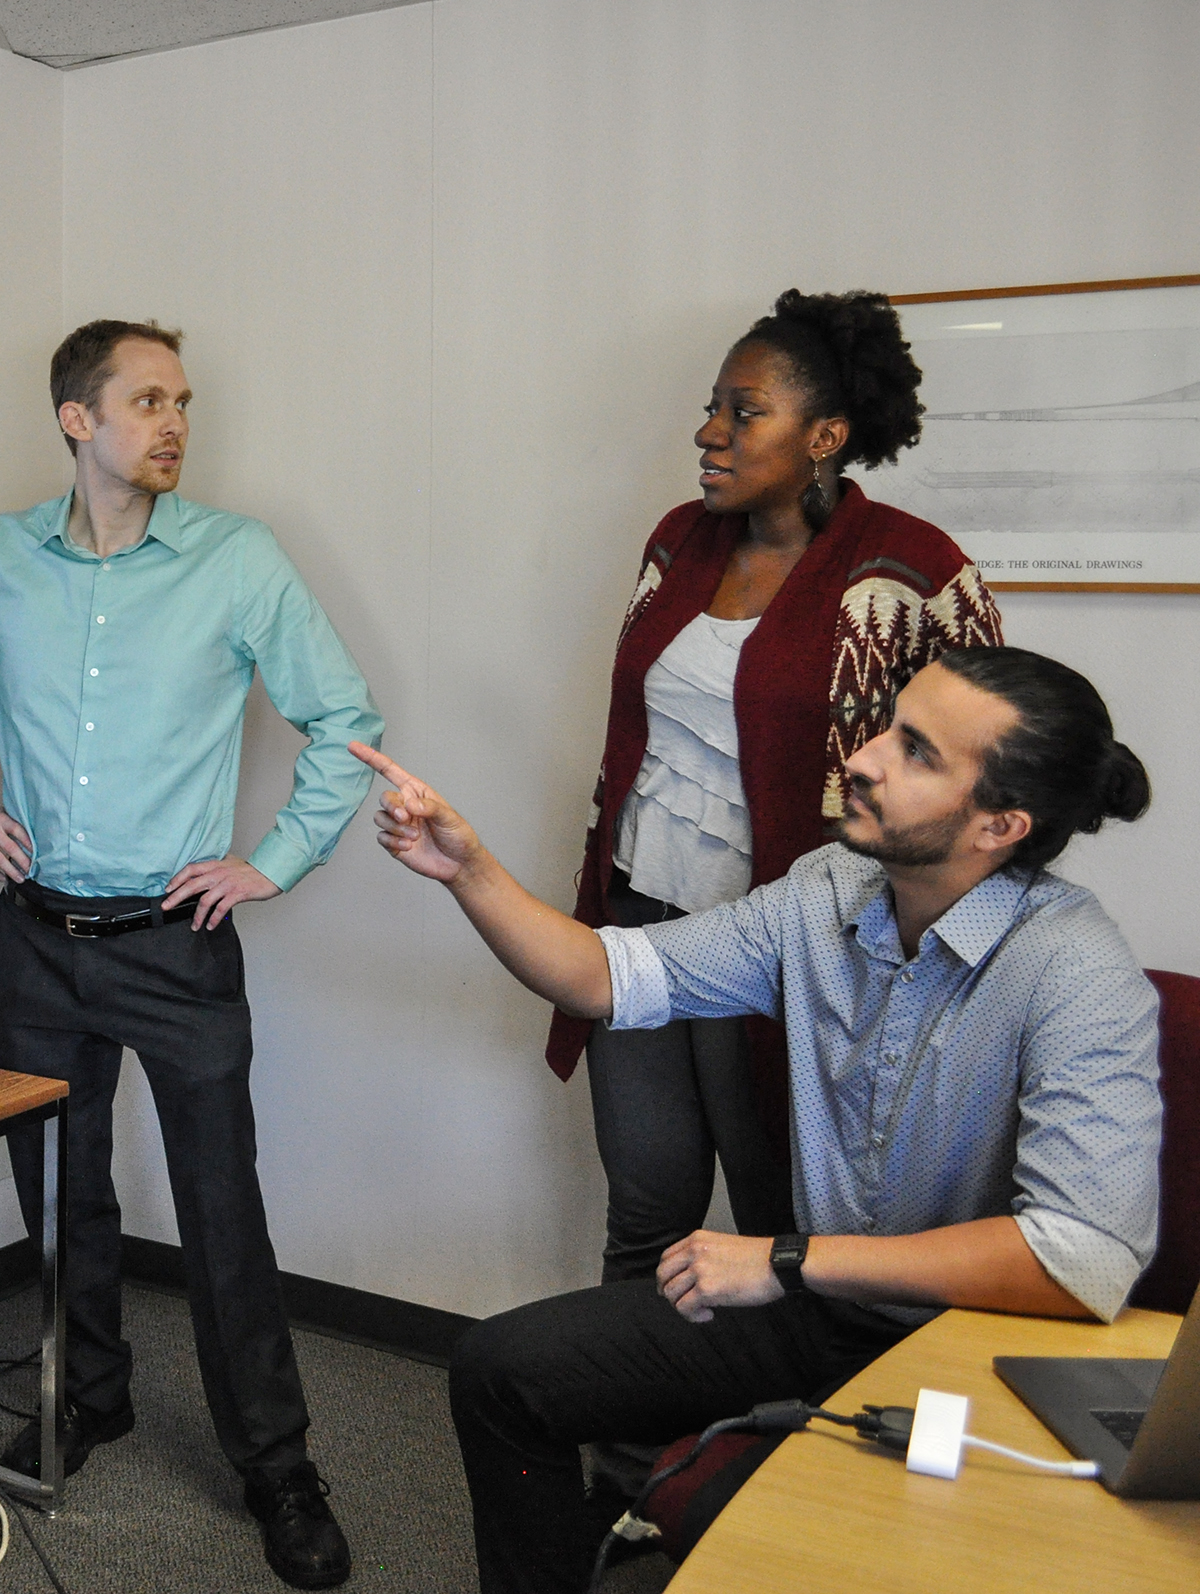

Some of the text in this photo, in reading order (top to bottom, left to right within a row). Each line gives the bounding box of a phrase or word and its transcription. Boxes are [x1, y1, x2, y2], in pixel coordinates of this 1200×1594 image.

[1007, 560, 1029, 570] THE
[1032, 559, 1082, 570] ORIGINAL
[1086, 559, 1143, 570] DRAWINGS
